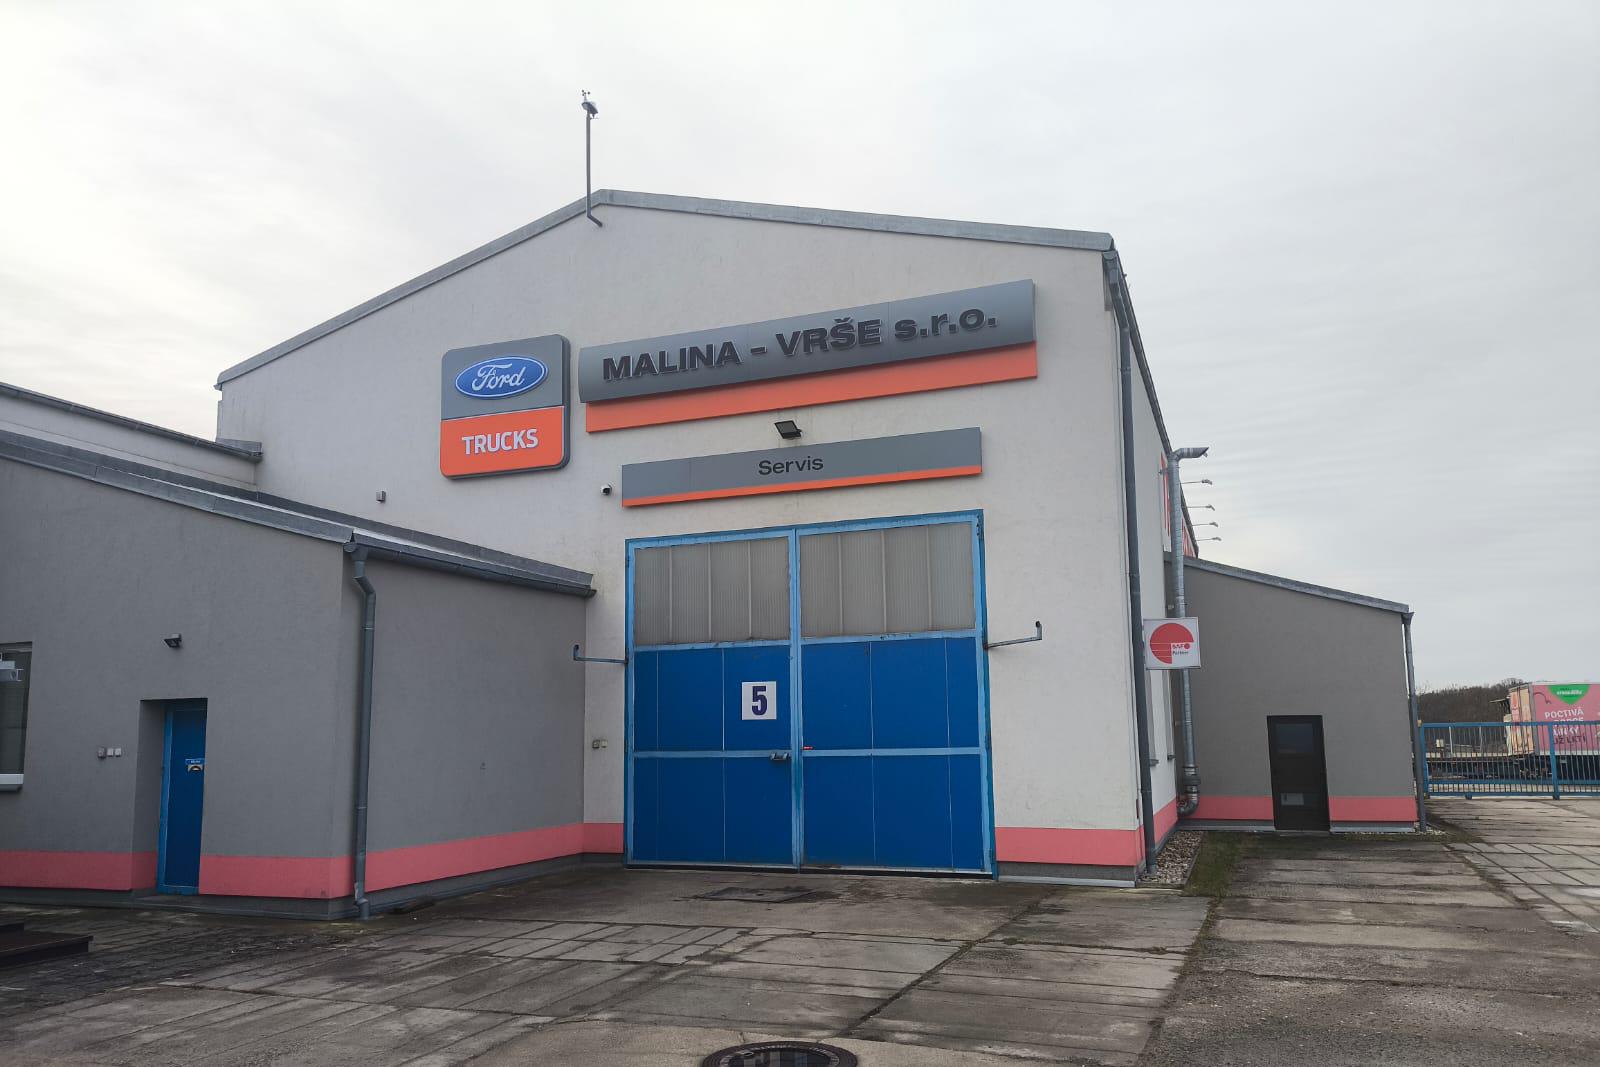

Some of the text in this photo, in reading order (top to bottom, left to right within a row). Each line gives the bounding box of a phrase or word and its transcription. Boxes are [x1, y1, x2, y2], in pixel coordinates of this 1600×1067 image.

[603, 309, 999, 382] MALINA - VRŠE s.r.o.
[471, 363, 526, 391] Ford
[462, 429, 539, 455] TRUCKS
[758, 456, 824, 475] Servis
[751, 685, 768, 716] 5
